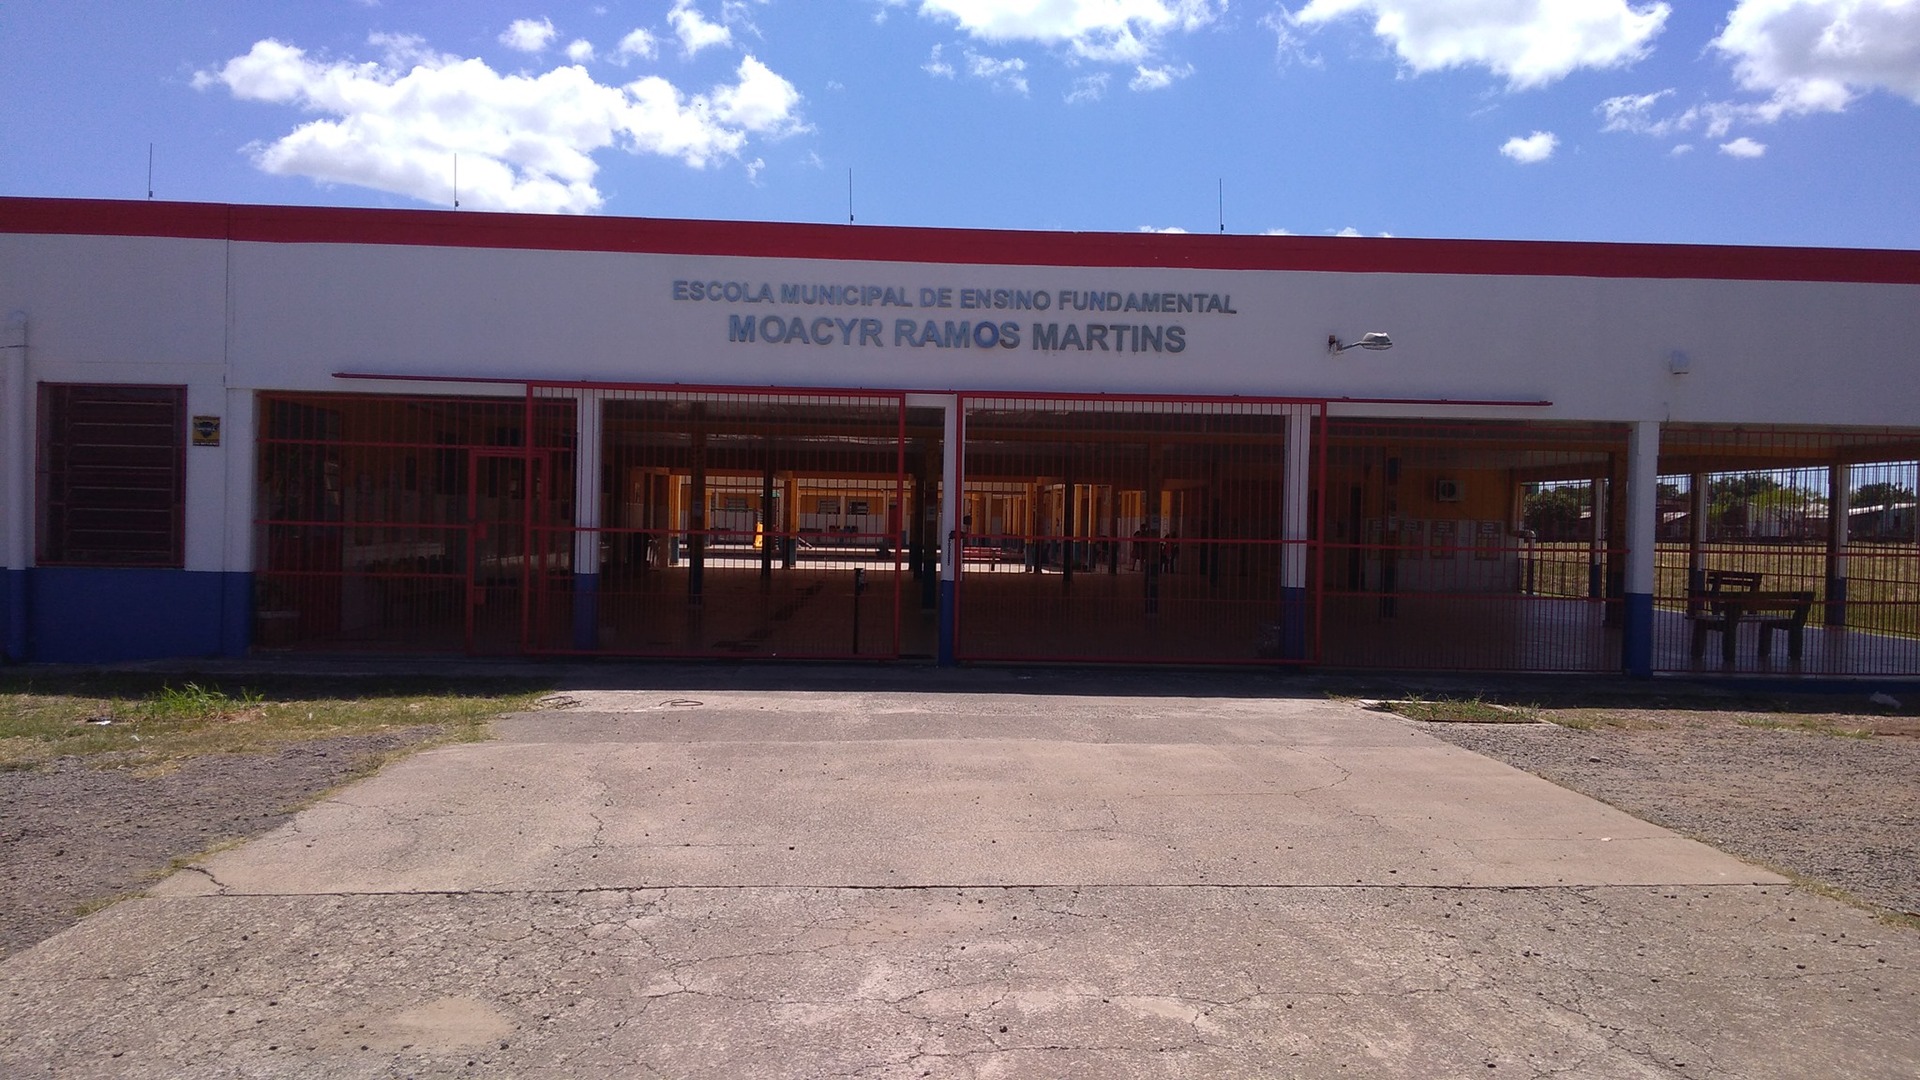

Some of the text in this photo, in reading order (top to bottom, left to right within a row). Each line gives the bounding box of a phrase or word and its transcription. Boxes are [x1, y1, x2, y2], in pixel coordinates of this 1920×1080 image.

[672, 280, 1237, 315] ESCOLA MUNICIPAL DE ENSINO FUNDAMENTAL
[728, 314, 1186, 353] MOACYR RAMOS MARTINS
